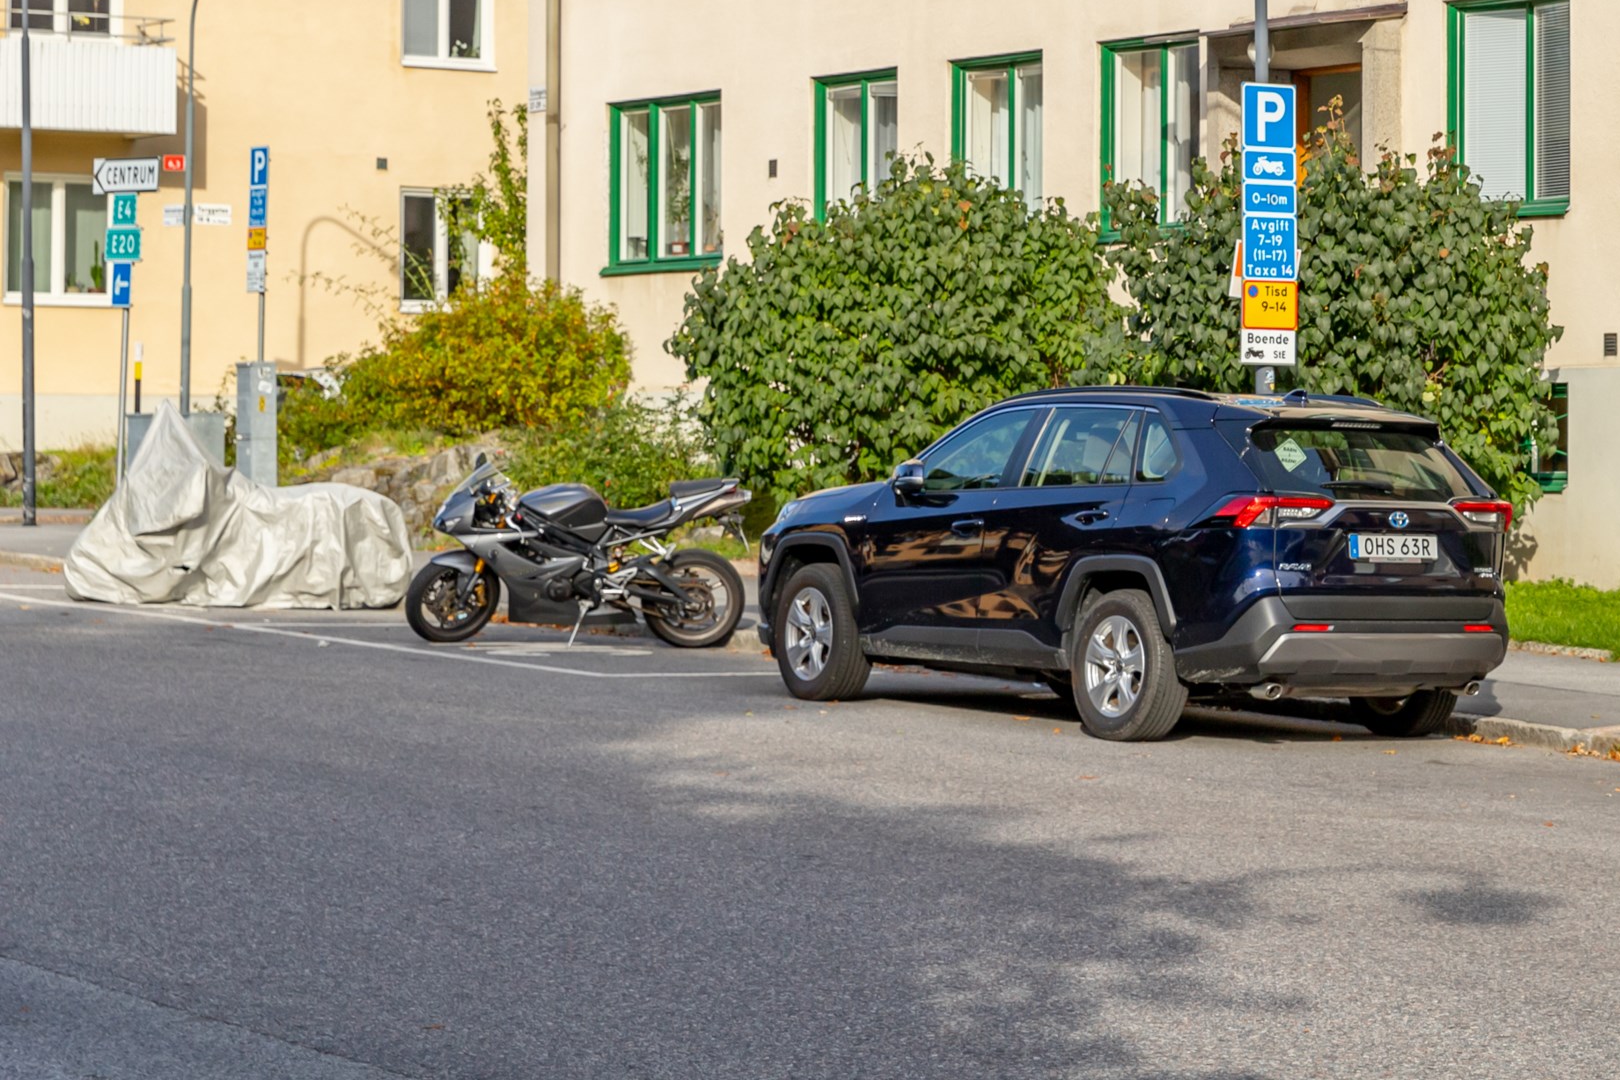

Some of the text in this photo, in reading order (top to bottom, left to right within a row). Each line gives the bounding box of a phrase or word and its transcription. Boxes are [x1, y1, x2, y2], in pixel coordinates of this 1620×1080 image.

[1257, 91, 1286, 142] P
[254, 150, 266, 184] P
[106, 165, 155, 185] CENTRUM
[1252, 192, 1288, 206] 0-10m
[117, 200, 132, 219] E4
[1251, 219, 1289, 233] Avgift
[111, 234, 135, 254] E20
[1257, 234, 1283, 247] 7-19
[1253, 249, 1287, 262] (11-17)
[1247, 264, 1293, 276] Taxa 14
[1265, 285, 1288, 297] Tisd
[1261, 302, 1287, 312] 9-14
[1247, 332, 1289, 345] Boende
[1364, 537, 1431, 556] OHS 63R
